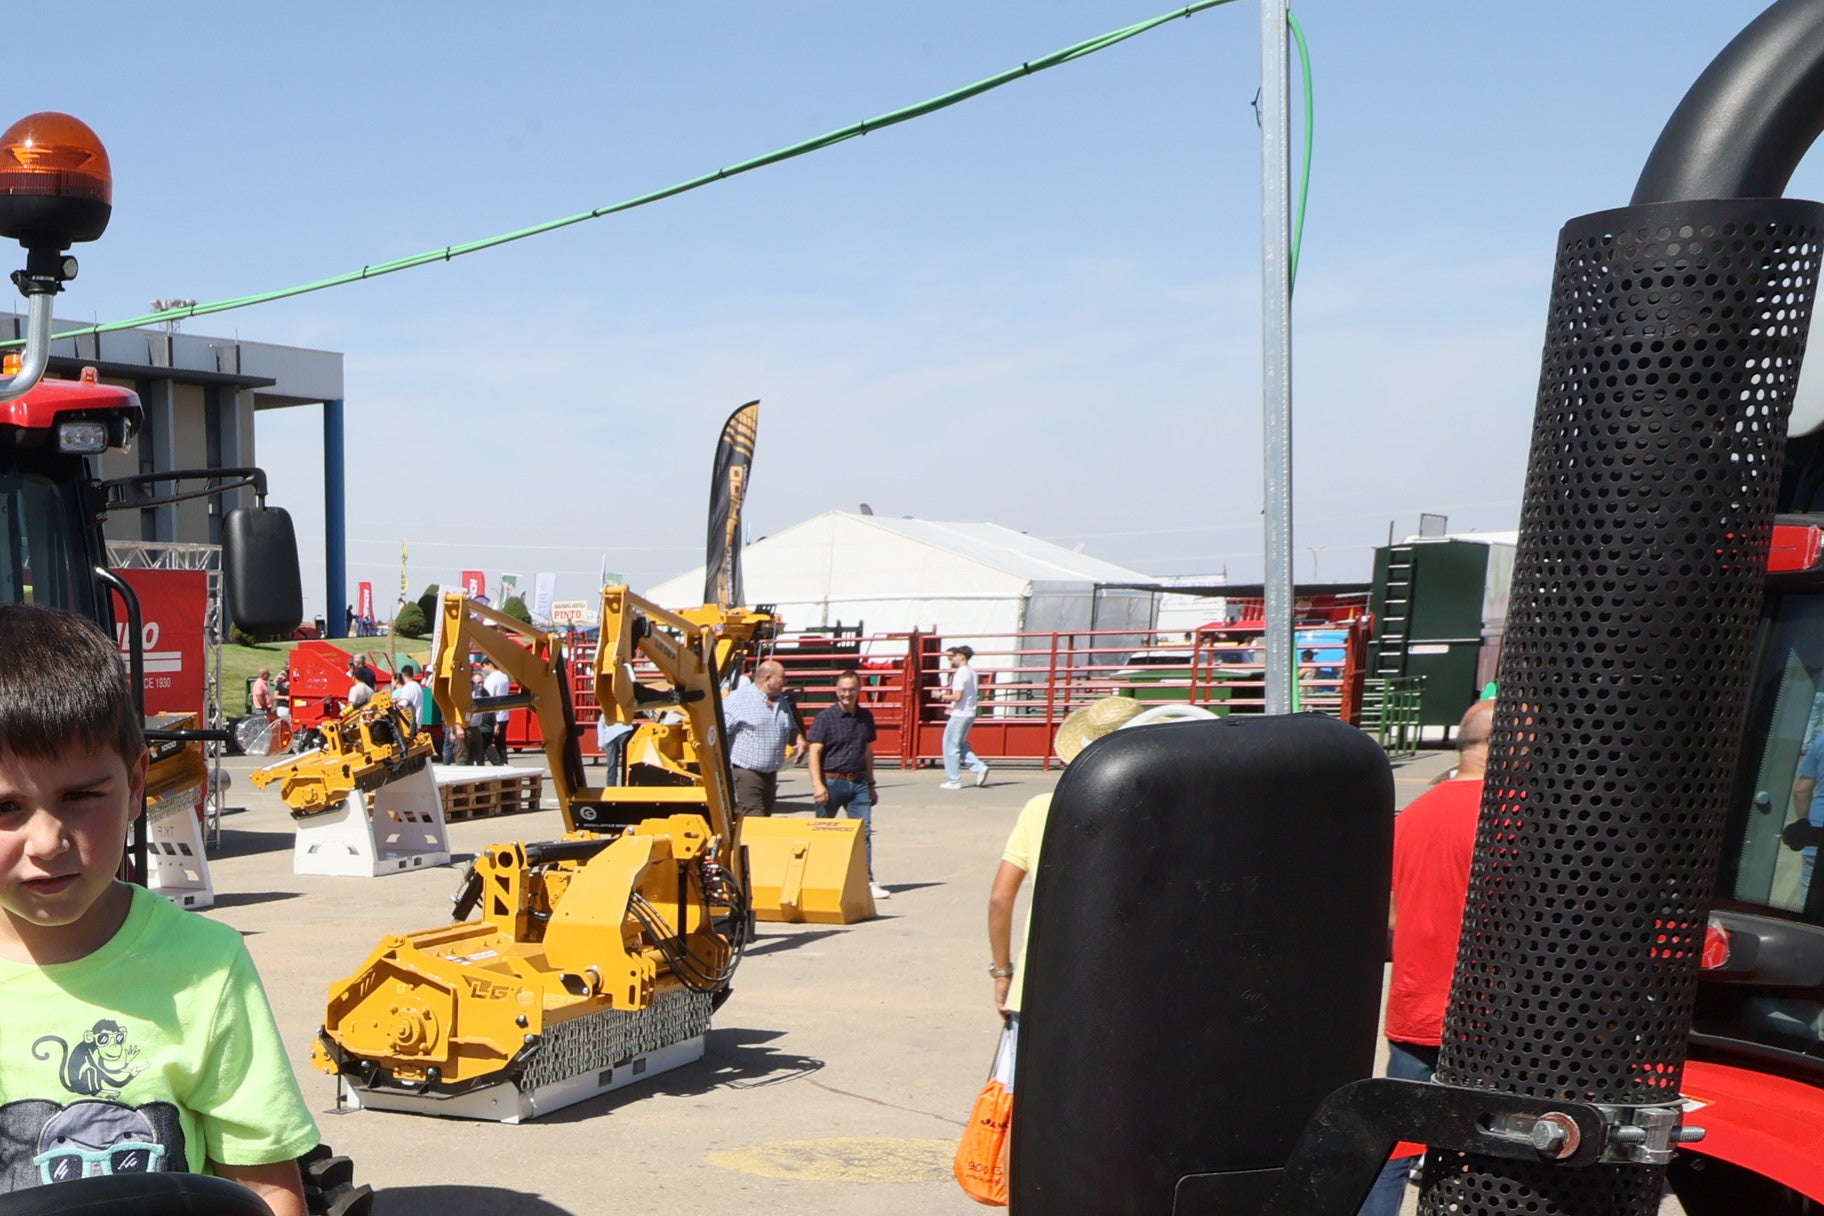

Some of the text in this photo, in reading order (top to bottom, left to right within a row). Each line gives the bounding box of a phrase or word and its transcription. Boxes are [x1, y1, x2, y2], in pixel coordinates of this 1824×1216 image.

[553, 610, 581, 620] PINTO
[155, 677, 171, 688] 1930
[161, 741, 177, 752] 1000
